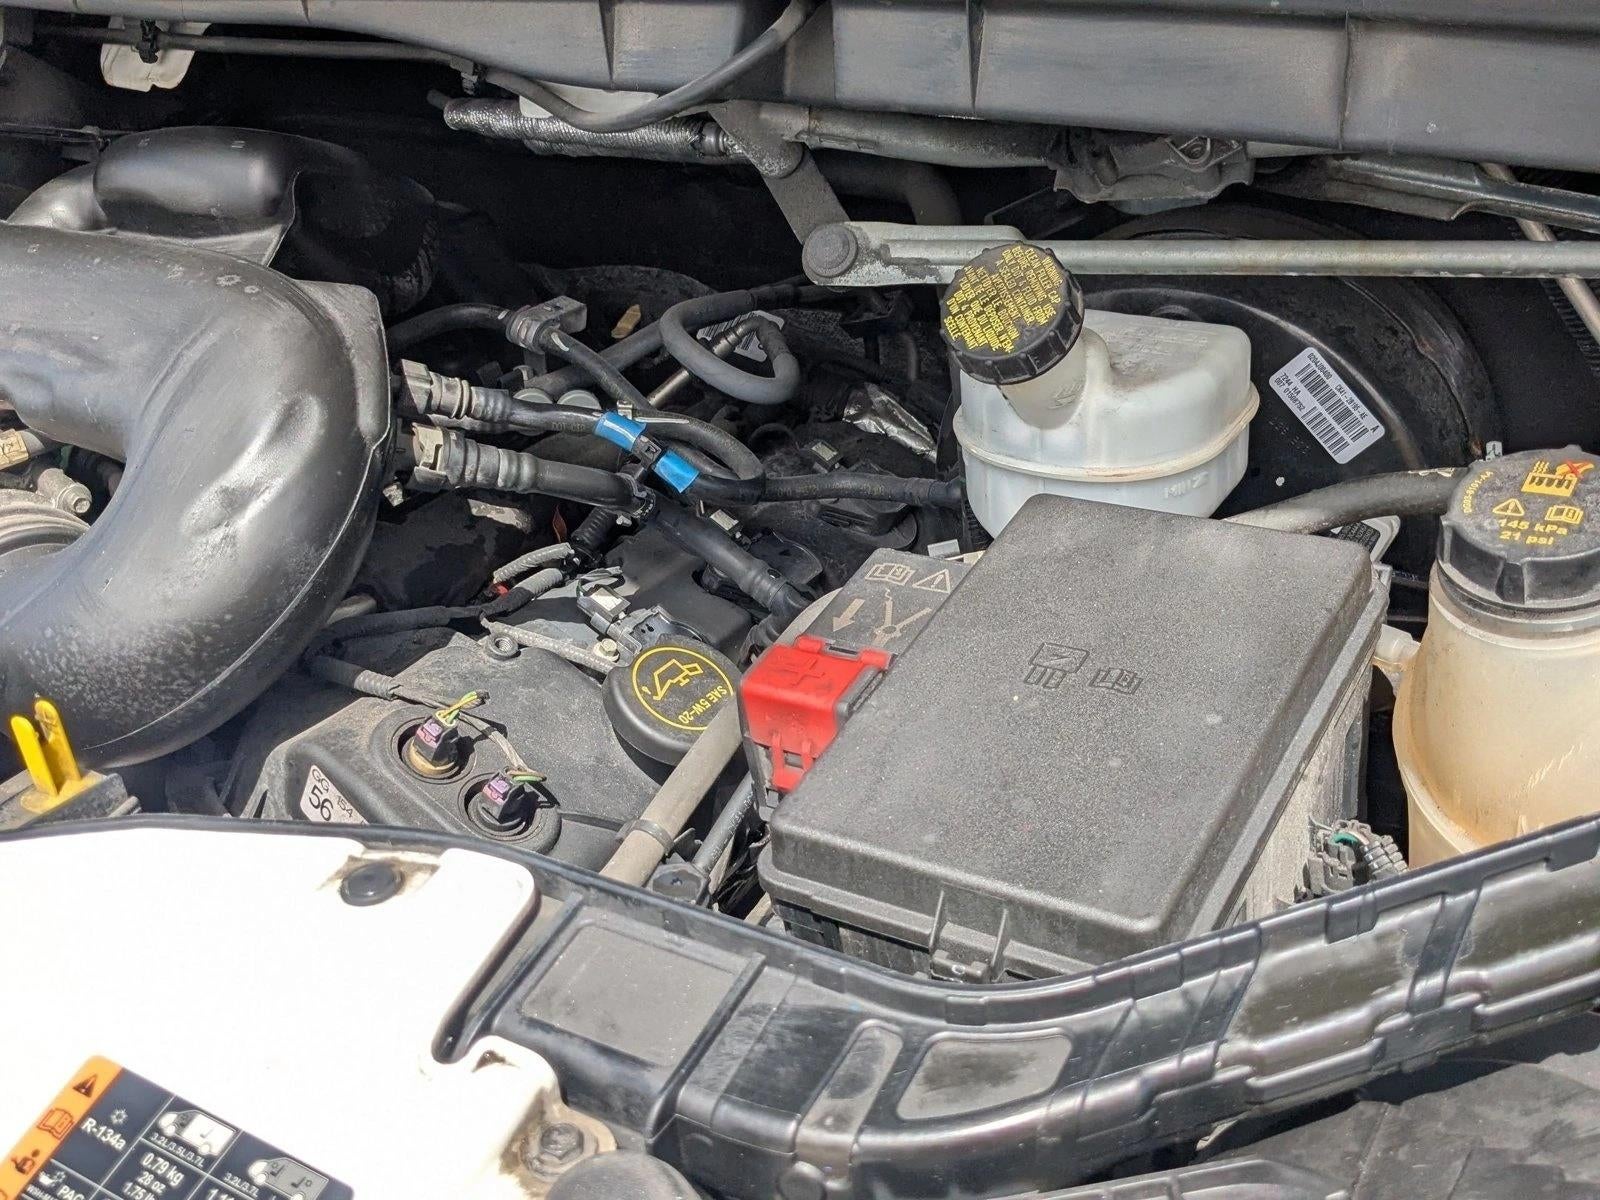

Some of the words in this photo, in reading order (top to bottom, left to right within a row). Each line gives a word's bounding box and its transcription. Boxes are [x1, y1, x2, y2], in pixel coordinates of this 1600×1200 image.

[995, 258, 1004, 266] A
[958, 276, 975, 301] PLOYER
[964, 265, 979, 285] AVANT
[974, 284, 984, 295] DE
[979, 294, 989, 305] LE
[999, 265, 1016, 289] SEALED
[1001, 249, 1016, 267] ONLY
[1011, 265, 1023, 280] DOT
[1021, 286, 1037, 306] FLUID
[1032, 305, 1047, 326] FROM
[1012, 245, 1030, 271] BEFORE
[1042, 303, 1056, 318] USE
[1024, 248, 1041, 269] CLEAN
[1036, 268, 1052, 291] FILLER
[1048, 290, 1060, 305] CAP
[970, 300, 983, 315] QUE
[976, 266, 997, 298] NETTOYER
[992, 297, 1002, 308] LE
[997, 309, 1019, 340] BOUCHON
[953, 290, 966, 304] DOT
[963, 310, 988, 347] PROVENANT
[977, 314, 988, 325] DU
[954, 314, 978, 351] CONTENANT
[982, 325, 1001, 351] LIQUIDE
[1370, 424, 1379, 433] A
[1497, 518, 1529, 531] 145
[1534, 522, 1568, 536] kPa
[1499, 530, 1520, 540] 21
[1525, 533, 1555, 546] psi
[705, 685, 728, 704] SAE
[678, 699, 712, 724] 5W-20
[308, 784, 334, 822] 56
[81, 1116, 127, 1151] R-134a
[141, 1152, 170, 1175] 0.79
[167, 1165, 185, 1187] kg
[137, 1171, 155, 1186] 28
[152, 1180, 167, 1194] oz
